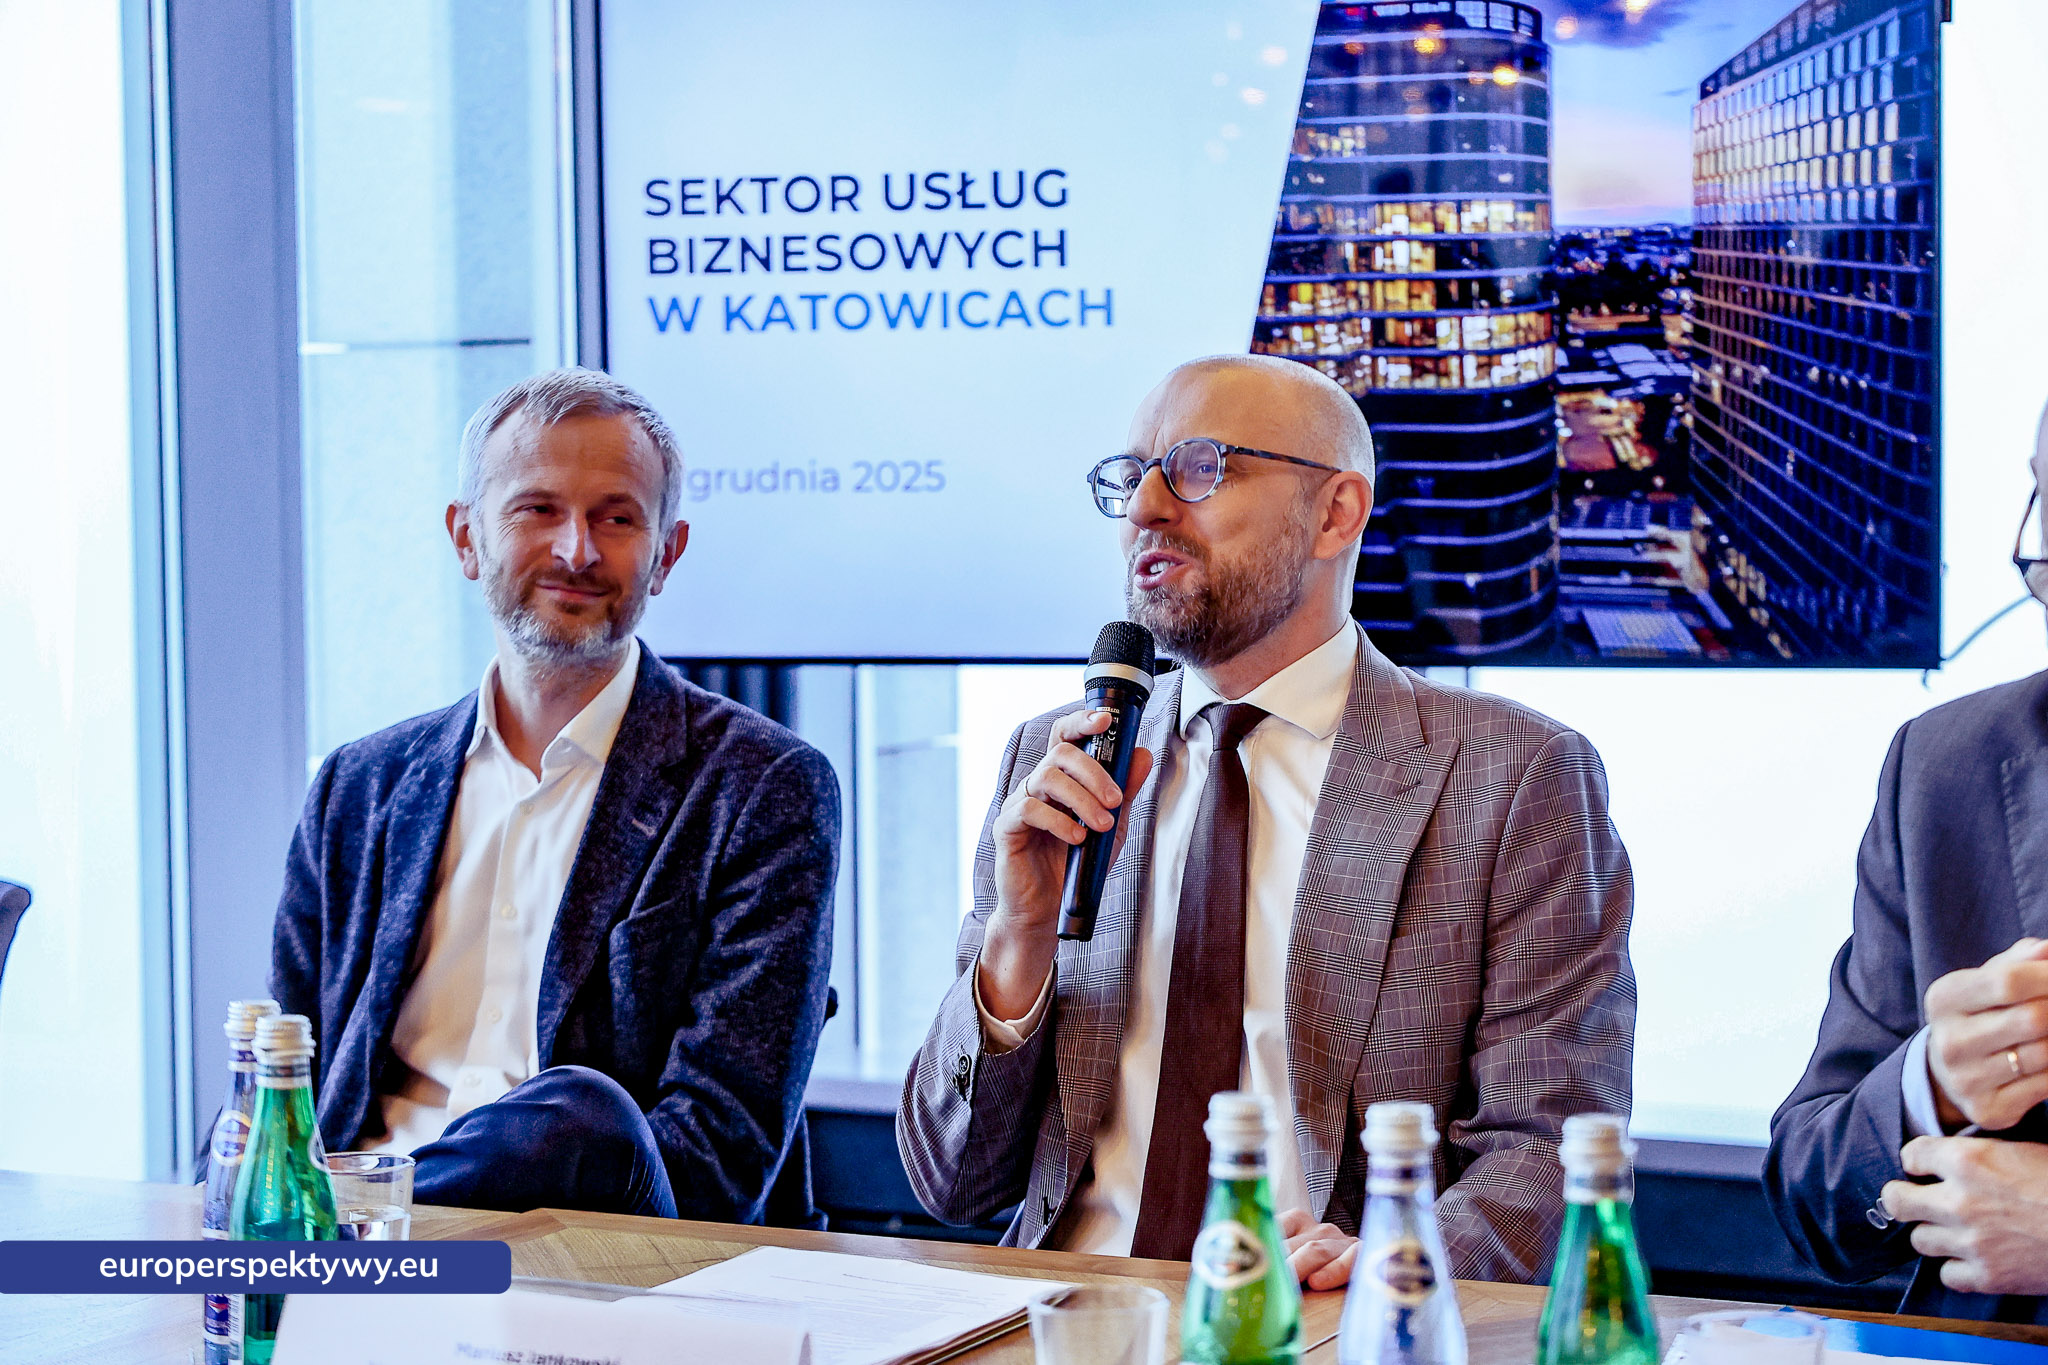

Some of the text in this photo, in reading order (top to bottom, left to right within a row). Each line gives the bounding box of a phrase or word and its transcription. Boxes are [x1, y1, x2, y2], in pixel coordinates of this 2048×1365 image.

[645, 168, 1068, 218] SEKTOR USŁUG
[647, 228, 1068, 276] BIZNESOWYCH
[647, 287, 1113, 334] W KATOWICACH
[687, 459, 946, 502] grudnia 2025
